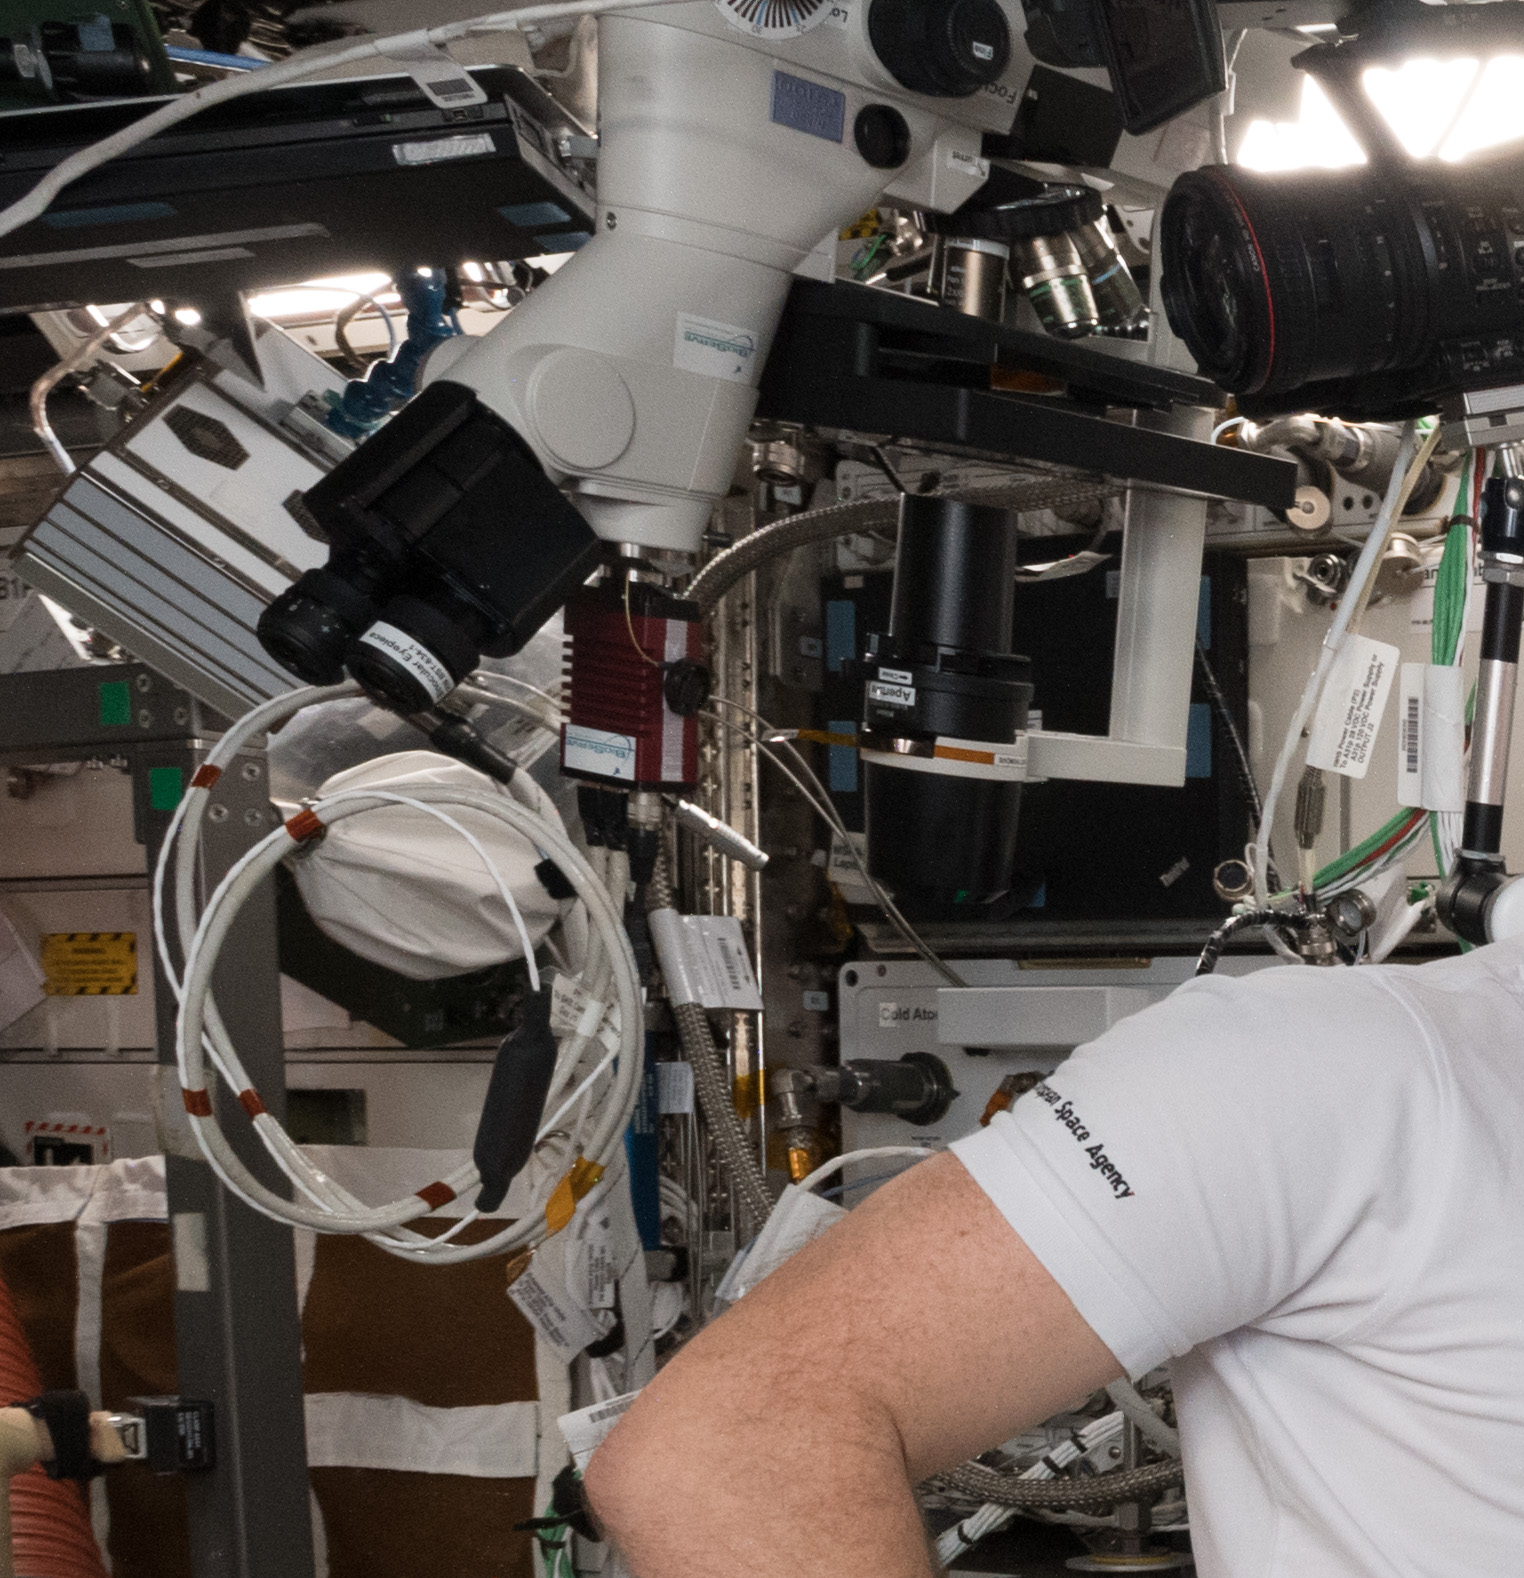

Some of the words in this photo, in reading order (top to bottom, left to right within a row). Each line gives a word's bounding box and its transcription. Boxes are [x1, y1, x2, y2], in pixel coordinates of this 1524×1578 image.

[1356, 694, 1367, 712] Power
[1363, 665, 1376, 688] Supply
[1366, 690, 1377, 710] Power
[1374, 662, 1385, 687] Supply
[1357, 734, 1371, 764] OUTPUT
[881, 1007, 910, 1020] Cold
[1054, 1100, 1091, 1142] Space
[1084, 1143, 1135, 1200] Agency
